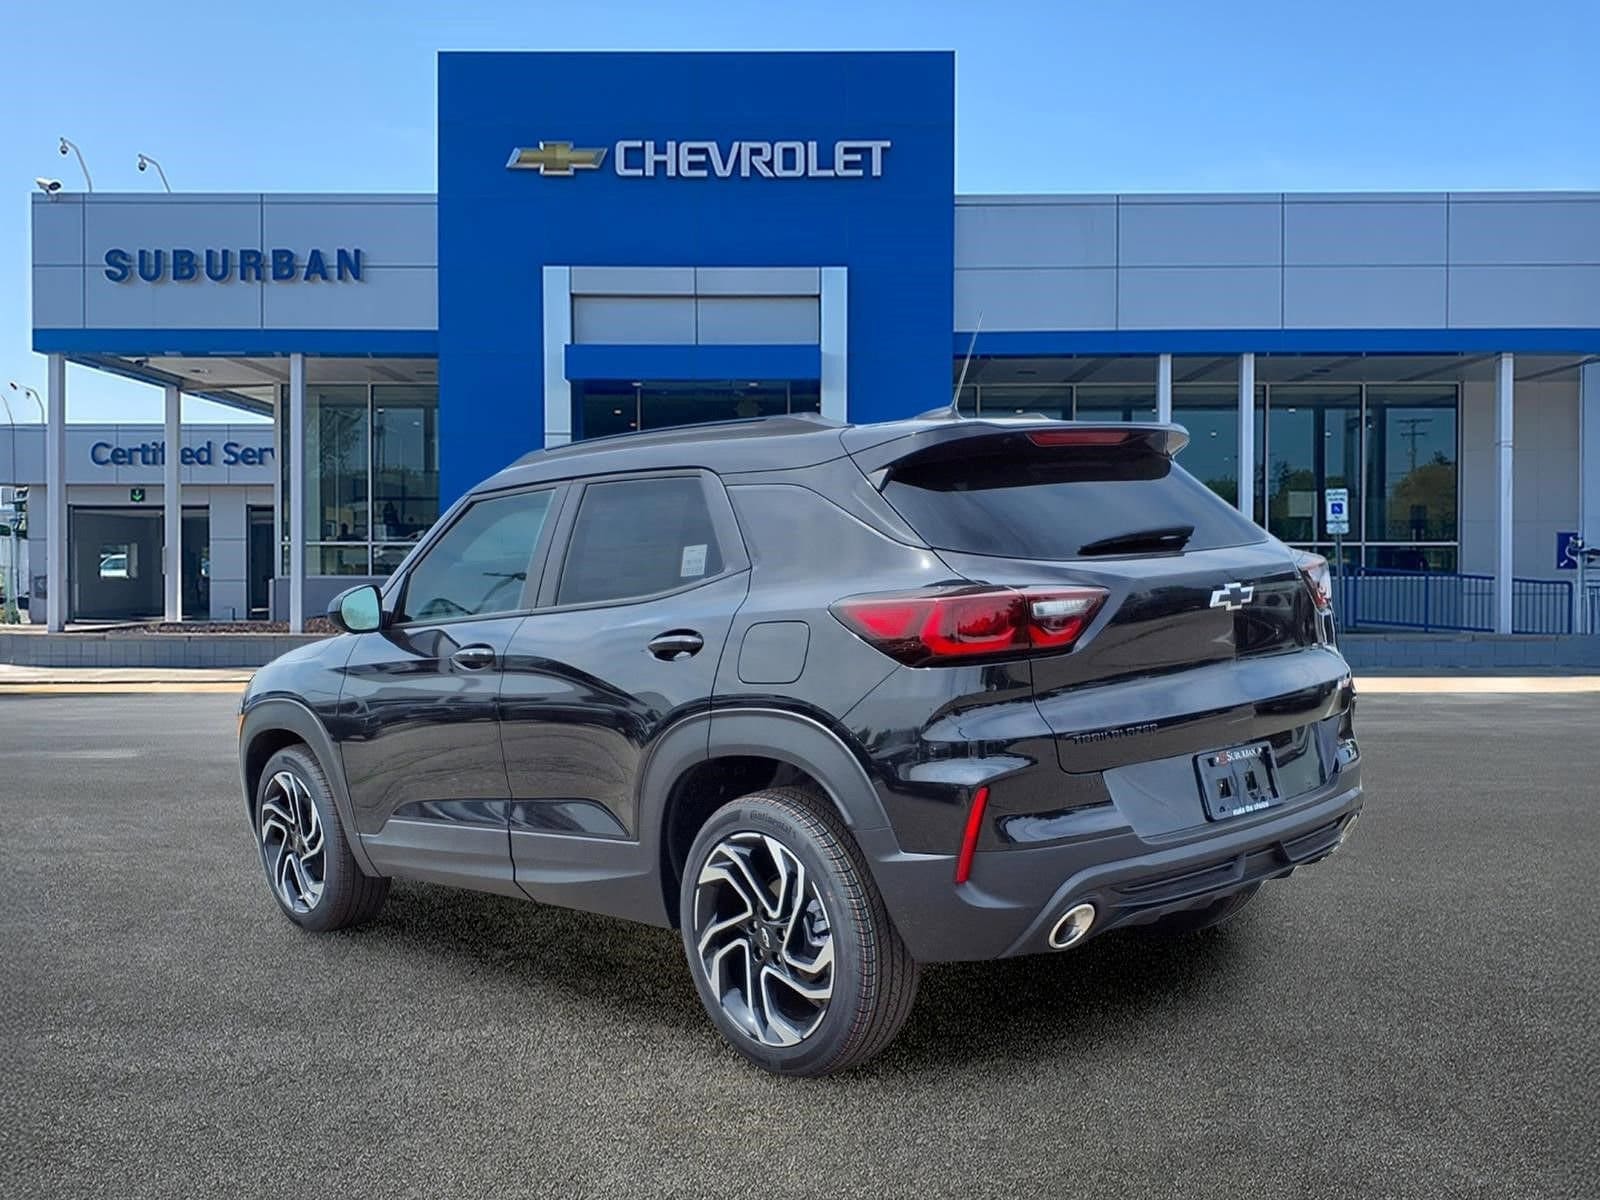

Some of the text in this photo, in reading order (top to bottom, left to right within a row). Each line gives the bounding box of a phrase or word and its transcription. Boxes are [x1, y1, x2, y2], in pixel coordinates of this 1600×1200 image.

[615, 140, 891, 178] CHEVROLET
[104, 248, 362, 282] SUBURBAN
[91, 441, 212, 466] Certifed
